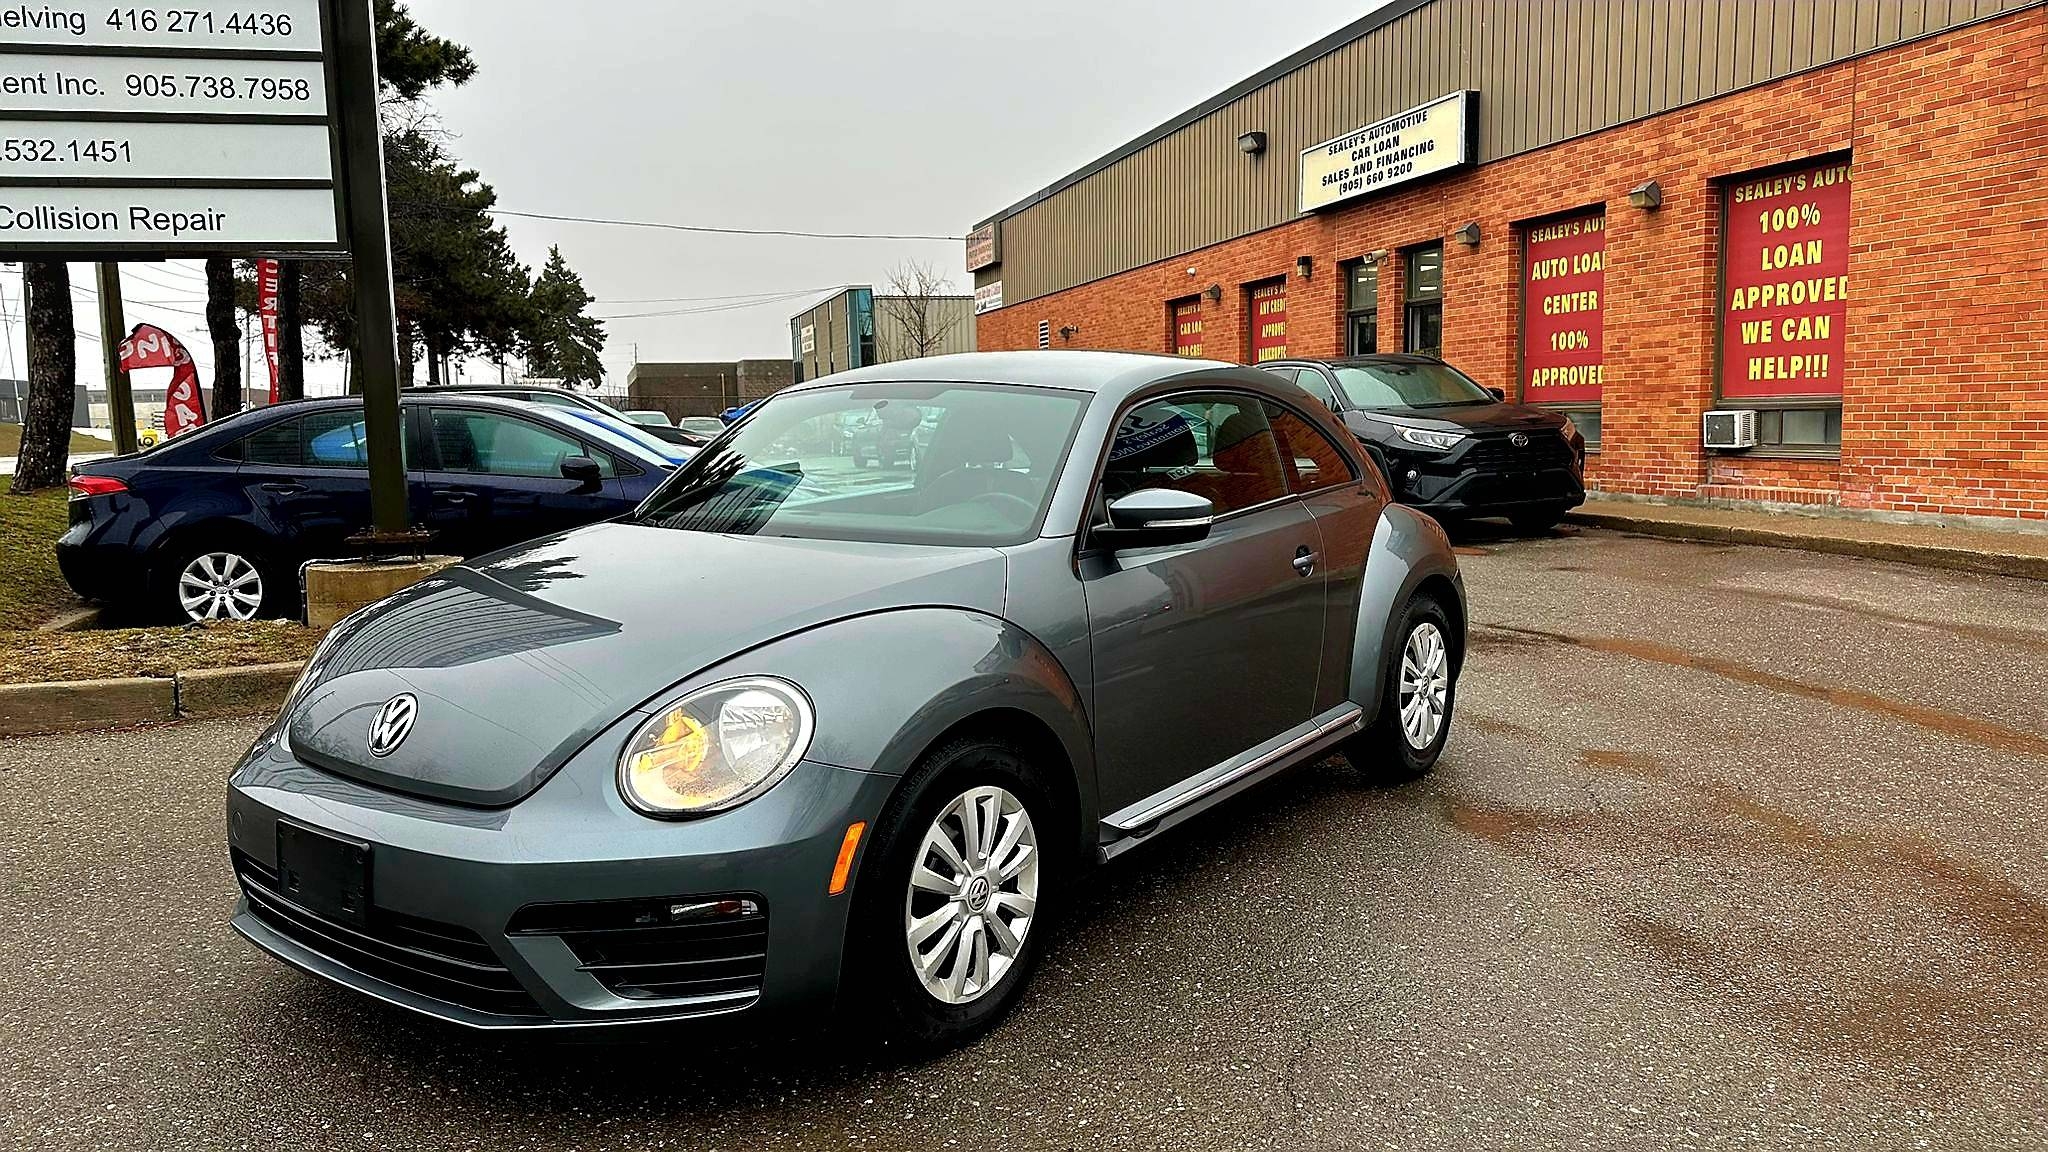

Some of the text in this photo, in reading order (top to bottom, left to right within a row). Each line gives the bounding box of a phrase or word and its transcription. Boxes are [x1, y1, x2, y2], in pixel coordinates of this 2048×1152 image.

[0, 5, 292, 36] elving 416 271.4436
[0, 72, 310, 101] ent Inc. 905.738.7958
[1328, 111, 1428, 156] SEALEY'S AUTOMOTIVE
[1351, 135, 1400, 162] CAR LOAN
[1322, 139, 1435, 187] SALES AND FINANCING
[1339, 161, 1413, 196] (905) 660 9200
[1735, 173, 1807, 203] SEALEY'S
[0, 205, 226, 237] Collision Repair
[1531, 221, 1580, 244] SEALEY'S
[1759, 202, 1822, 234] 100%
[1531, 256, 1568, 281] AUTO
[1761, 239, 1823, 271] LOAN
[1260, 300, 1270, 315] ANY
[1543, 290, 1599, 316] CENTER
[1731, 275, 1849, 311] APPROVED
[1551, 330, 1589, 351] 100%
[1741, 315, 1831, 345] WE CAN
[1748, 354, 1830, 381] HELP!!!
[367, 691, 419, 759] VW
